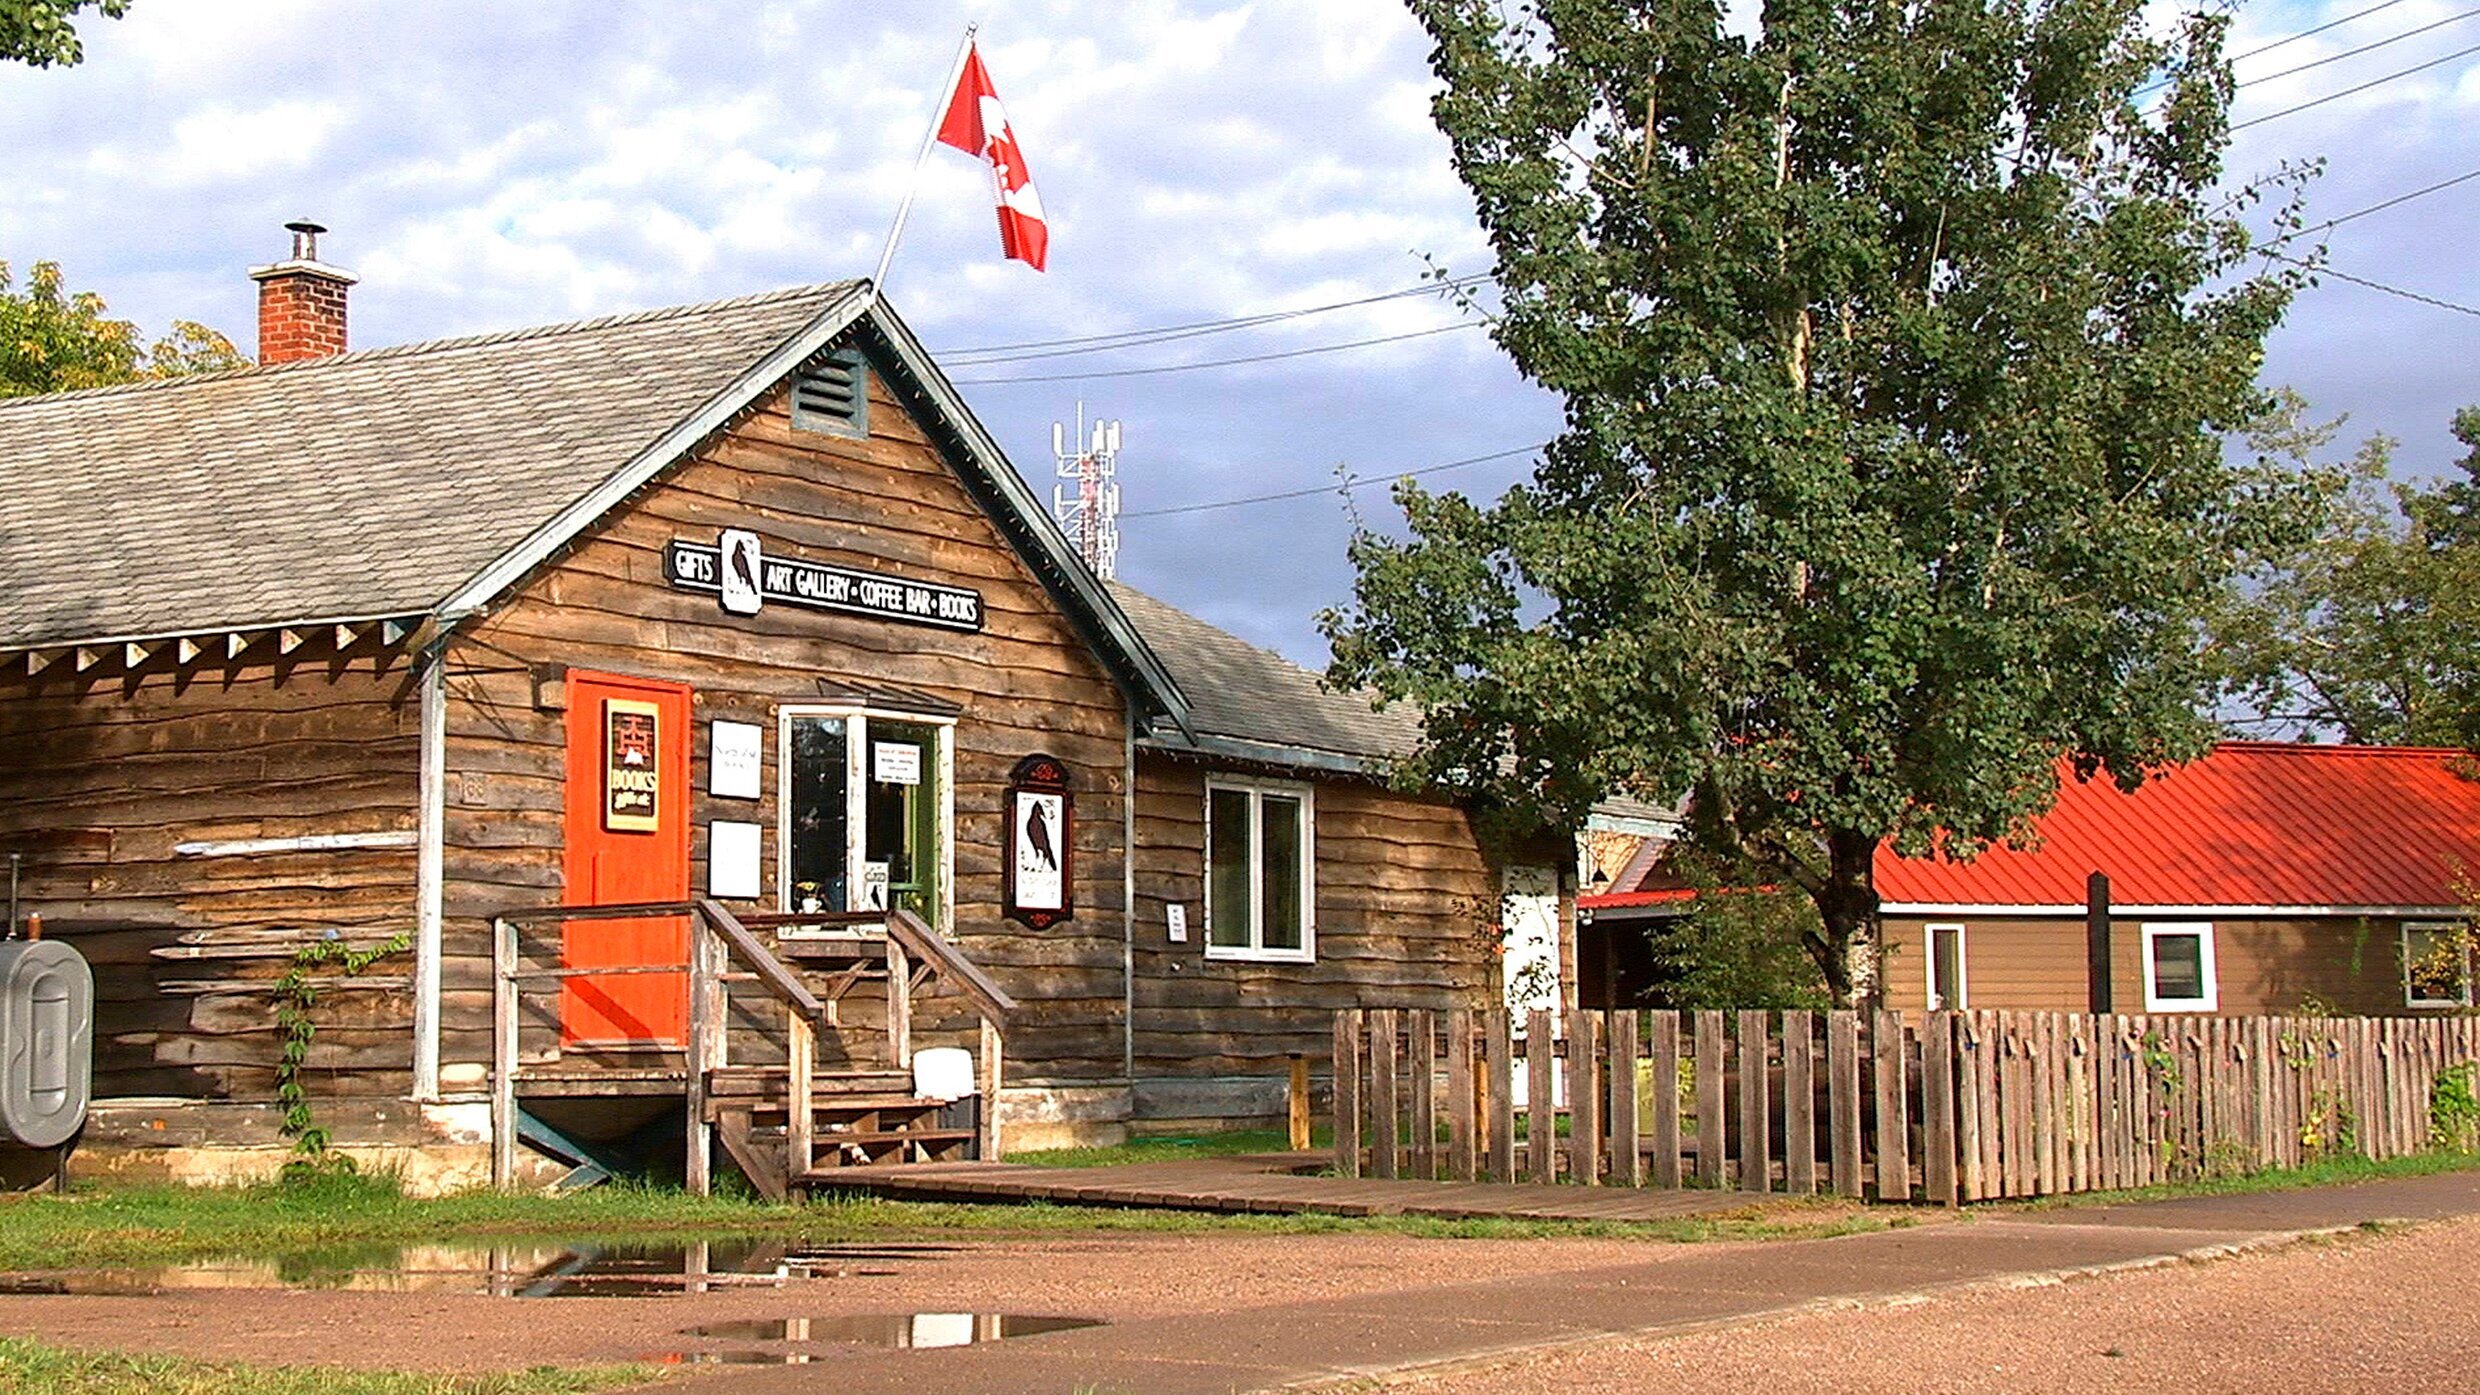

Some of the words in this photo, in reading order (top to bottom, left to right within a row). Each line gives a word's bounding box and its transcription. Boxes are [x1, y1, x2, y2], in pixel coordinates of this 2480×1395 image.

[675, 550, 714, 582] GIFTS
[766, 564, 793, 593] ART
[795, 569, 851, 602] GALLERY
[859, 580, 904, 611] COFFEE
[905, 587, 931, 615] BAR
[938, 592, 978, 622] BOOKS
[611, 769, 656, 792] BOOKS
